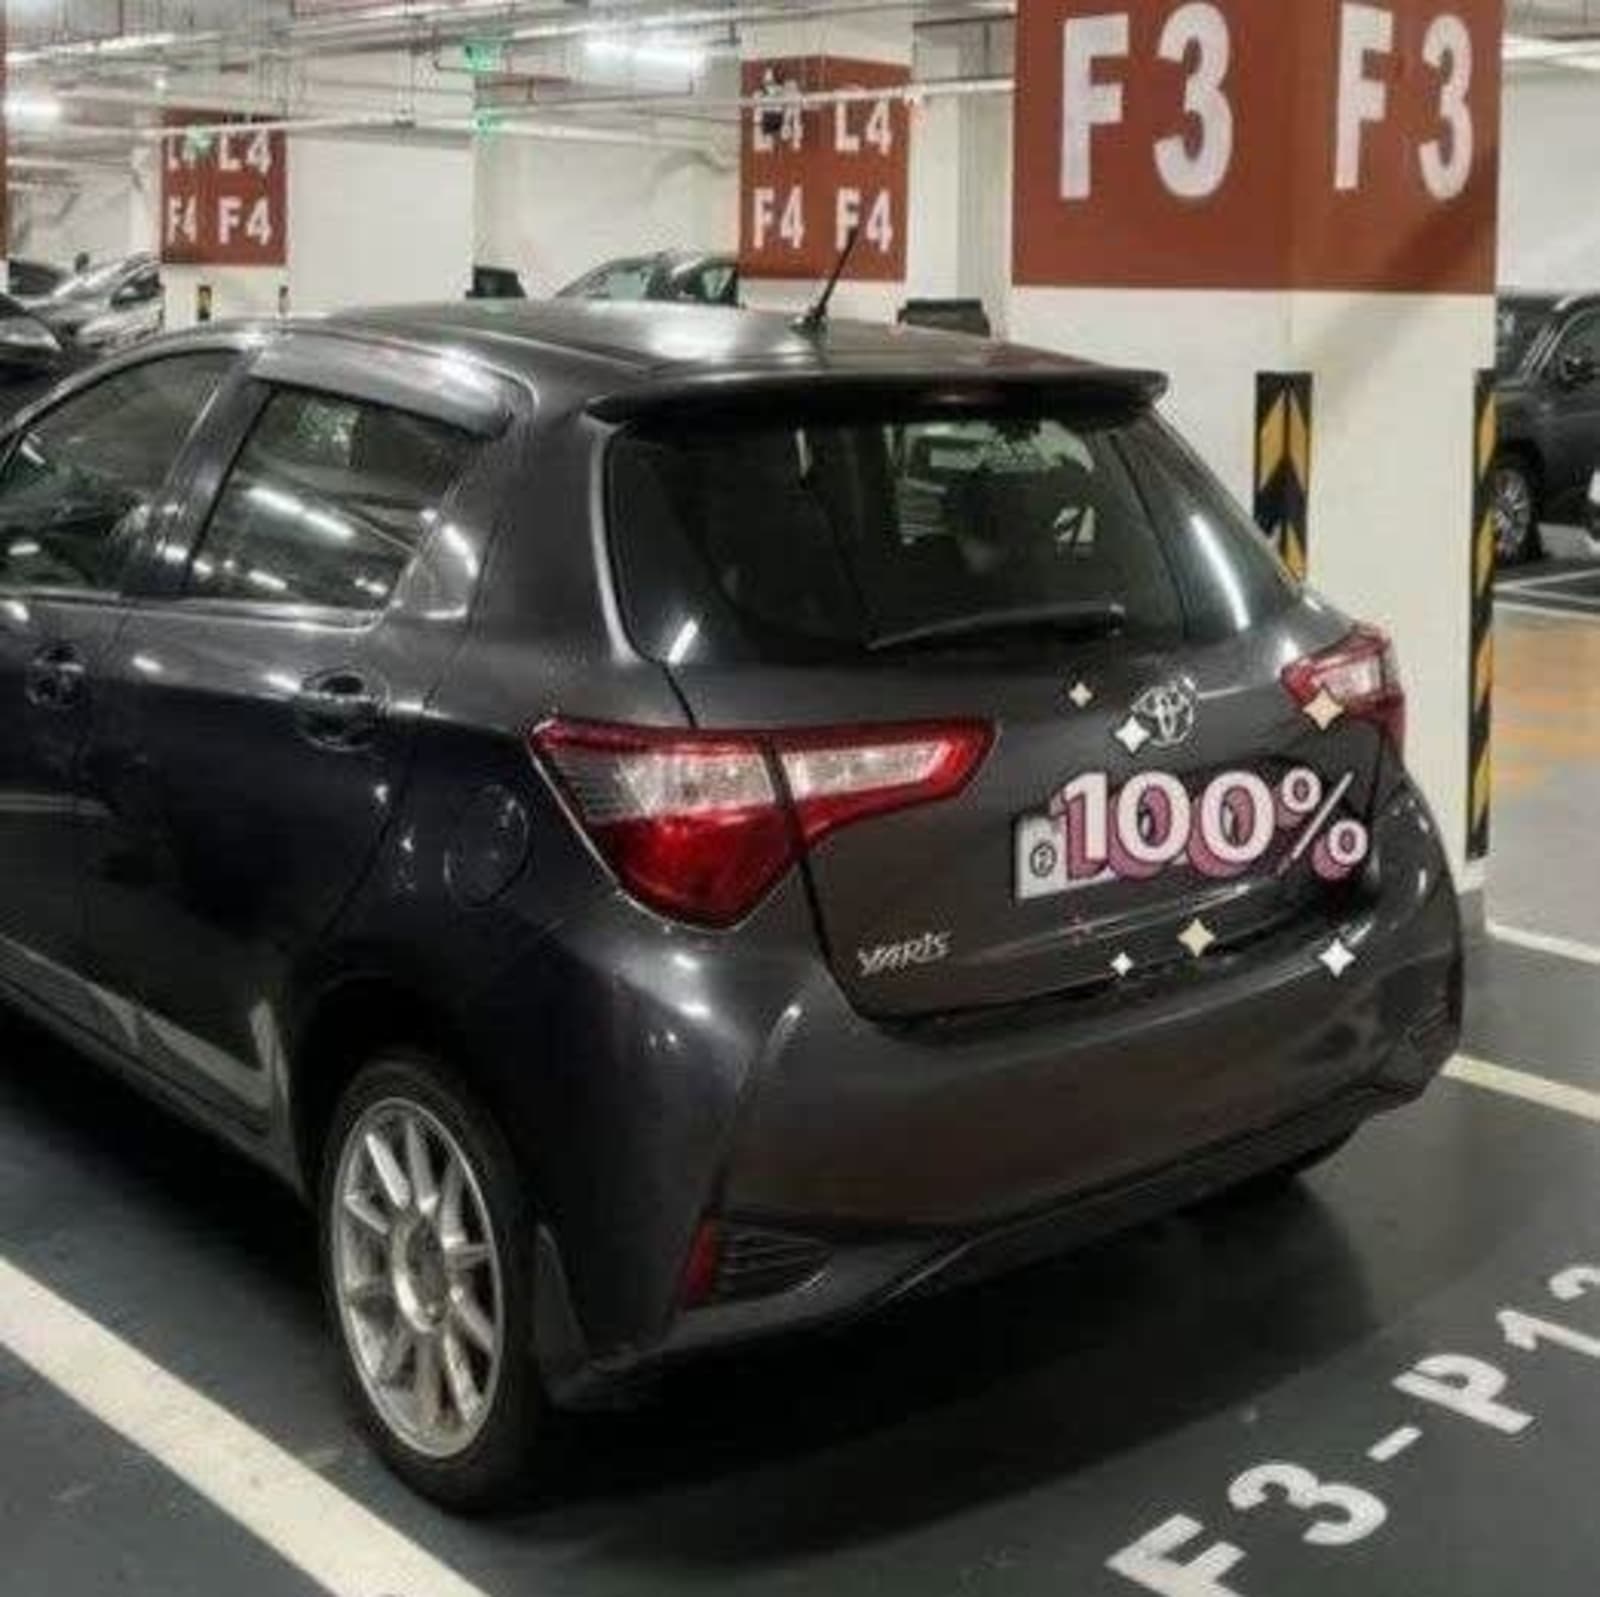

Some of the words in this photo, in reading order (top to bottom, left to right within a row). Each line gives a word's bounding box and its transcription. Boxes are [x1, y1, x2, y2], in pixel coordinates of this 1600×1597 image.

[835, 86, 892, 154] L4
[1060, 4, 1233, 200] F3
[1335, 2, 1472, 200] F3
[219, 127, 272, 175] L4
[168, 196, 197, 246] F4
[218, 196, 272, 246] F4
[753, 186, 804, 249] F4
[835, 187, 893, 252] F4
